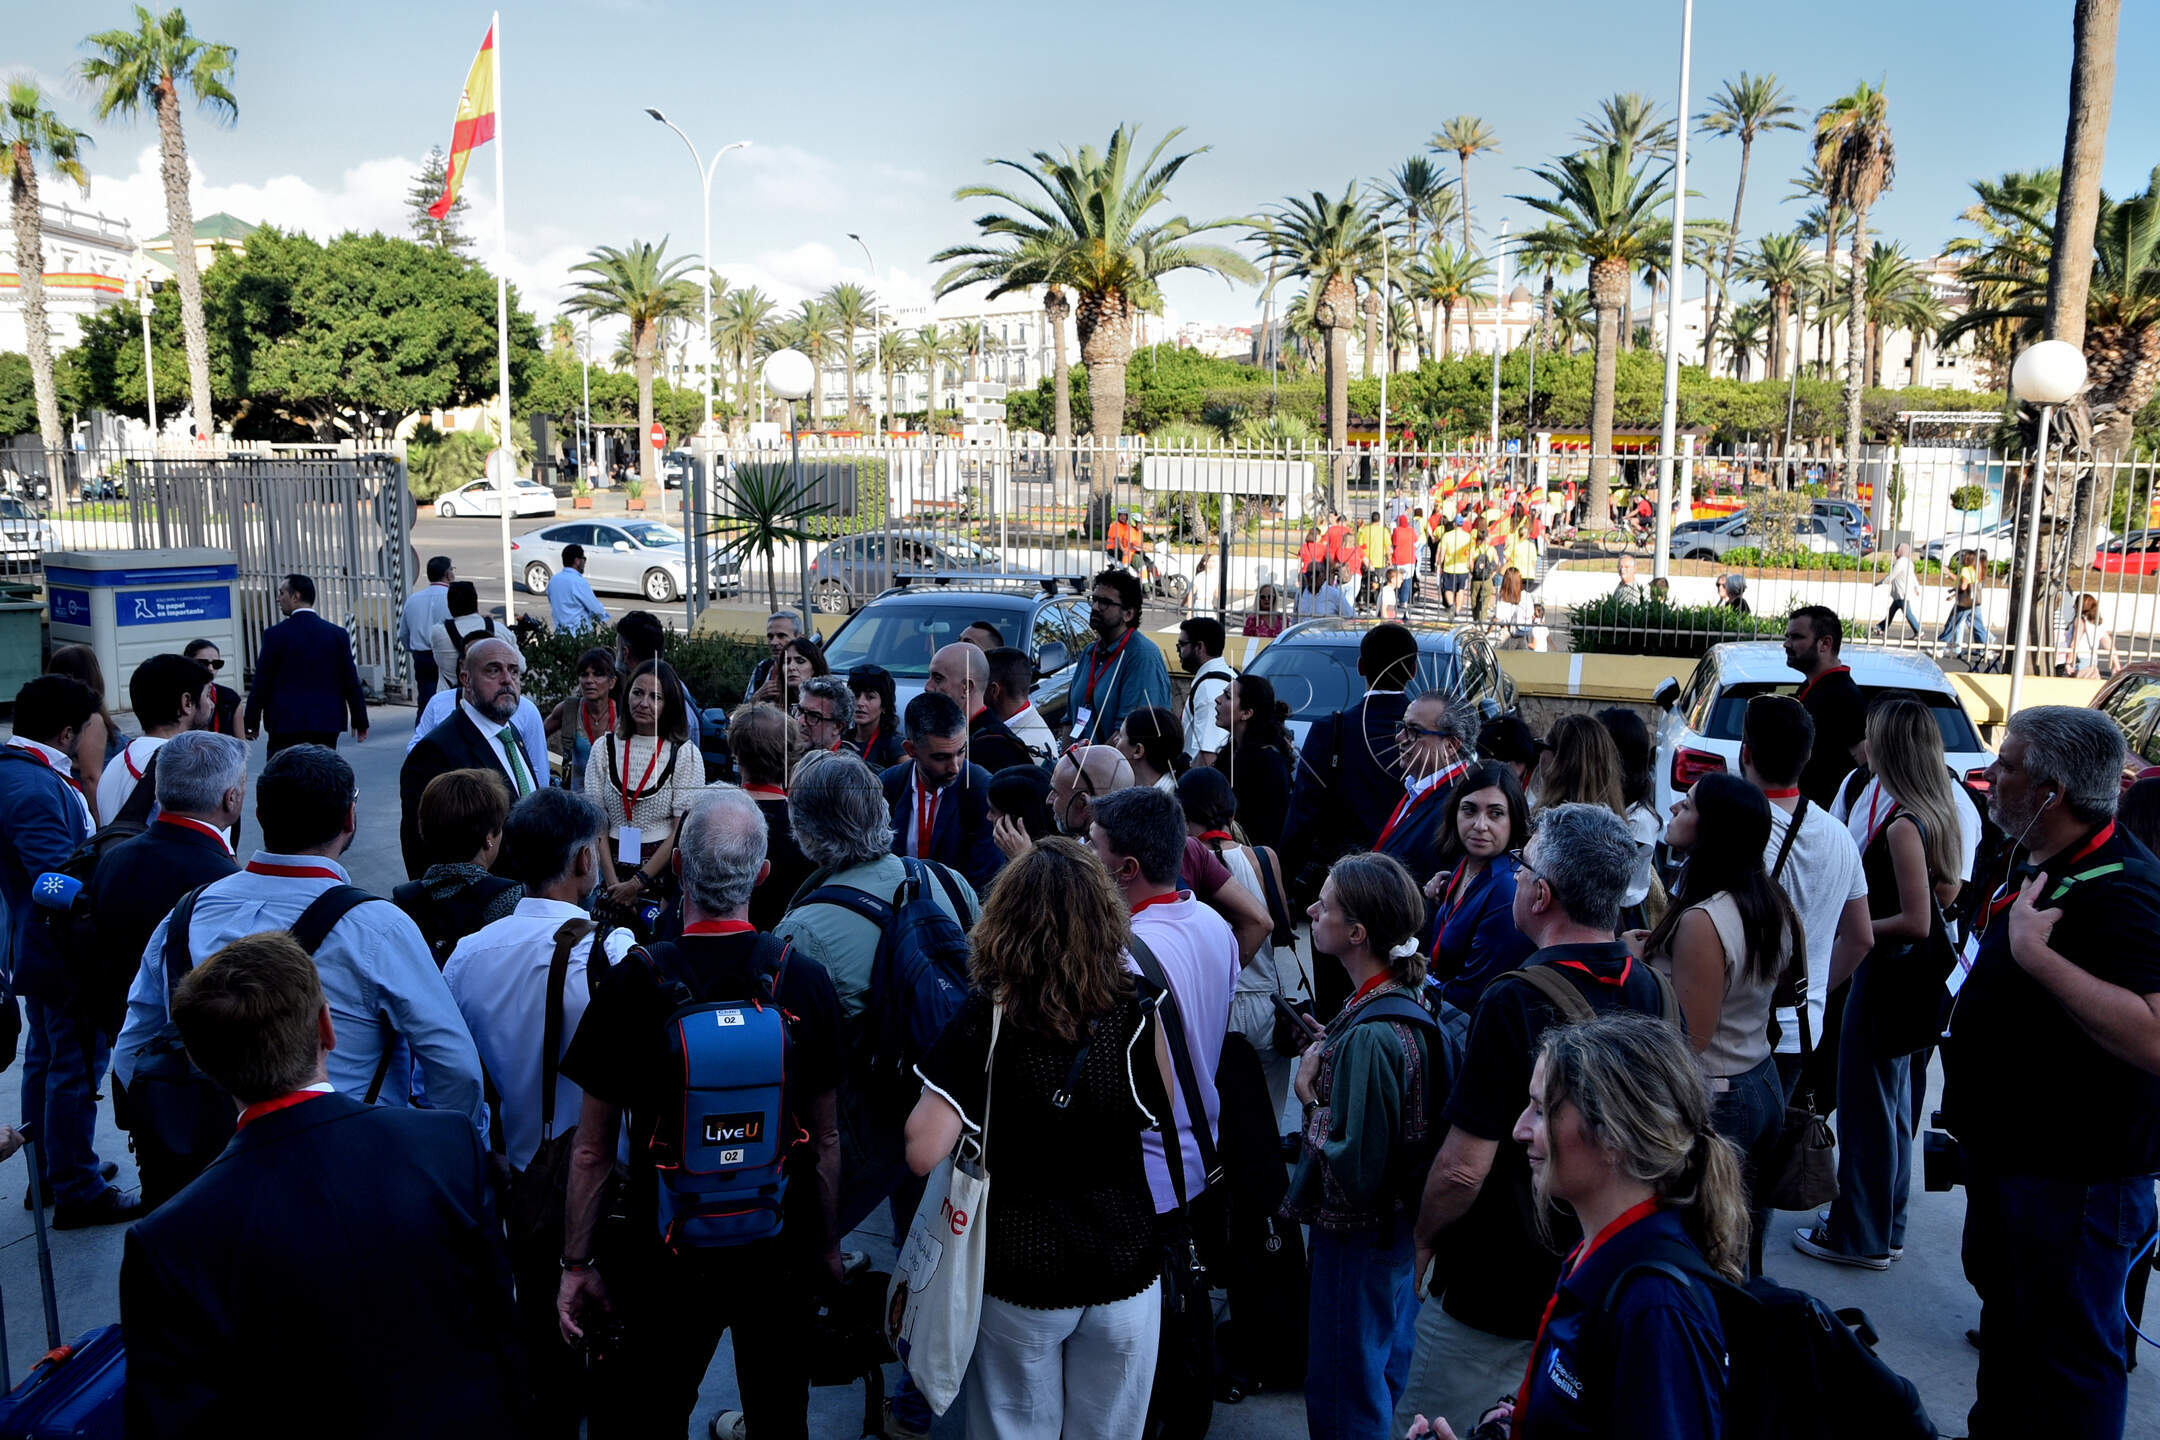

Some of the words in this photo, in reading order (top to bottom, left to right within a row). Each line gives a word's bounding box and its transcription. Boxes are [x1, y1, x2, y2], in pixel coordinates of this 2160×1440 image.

[166, 608, 205, 617] importante
[724, 1016, 737, 1024] 02
[706, 1121, 760, 1141] LiveU
[724, 1151, 739, 1161] 02
[1550, 1369, 1578, 1400] Melilla
